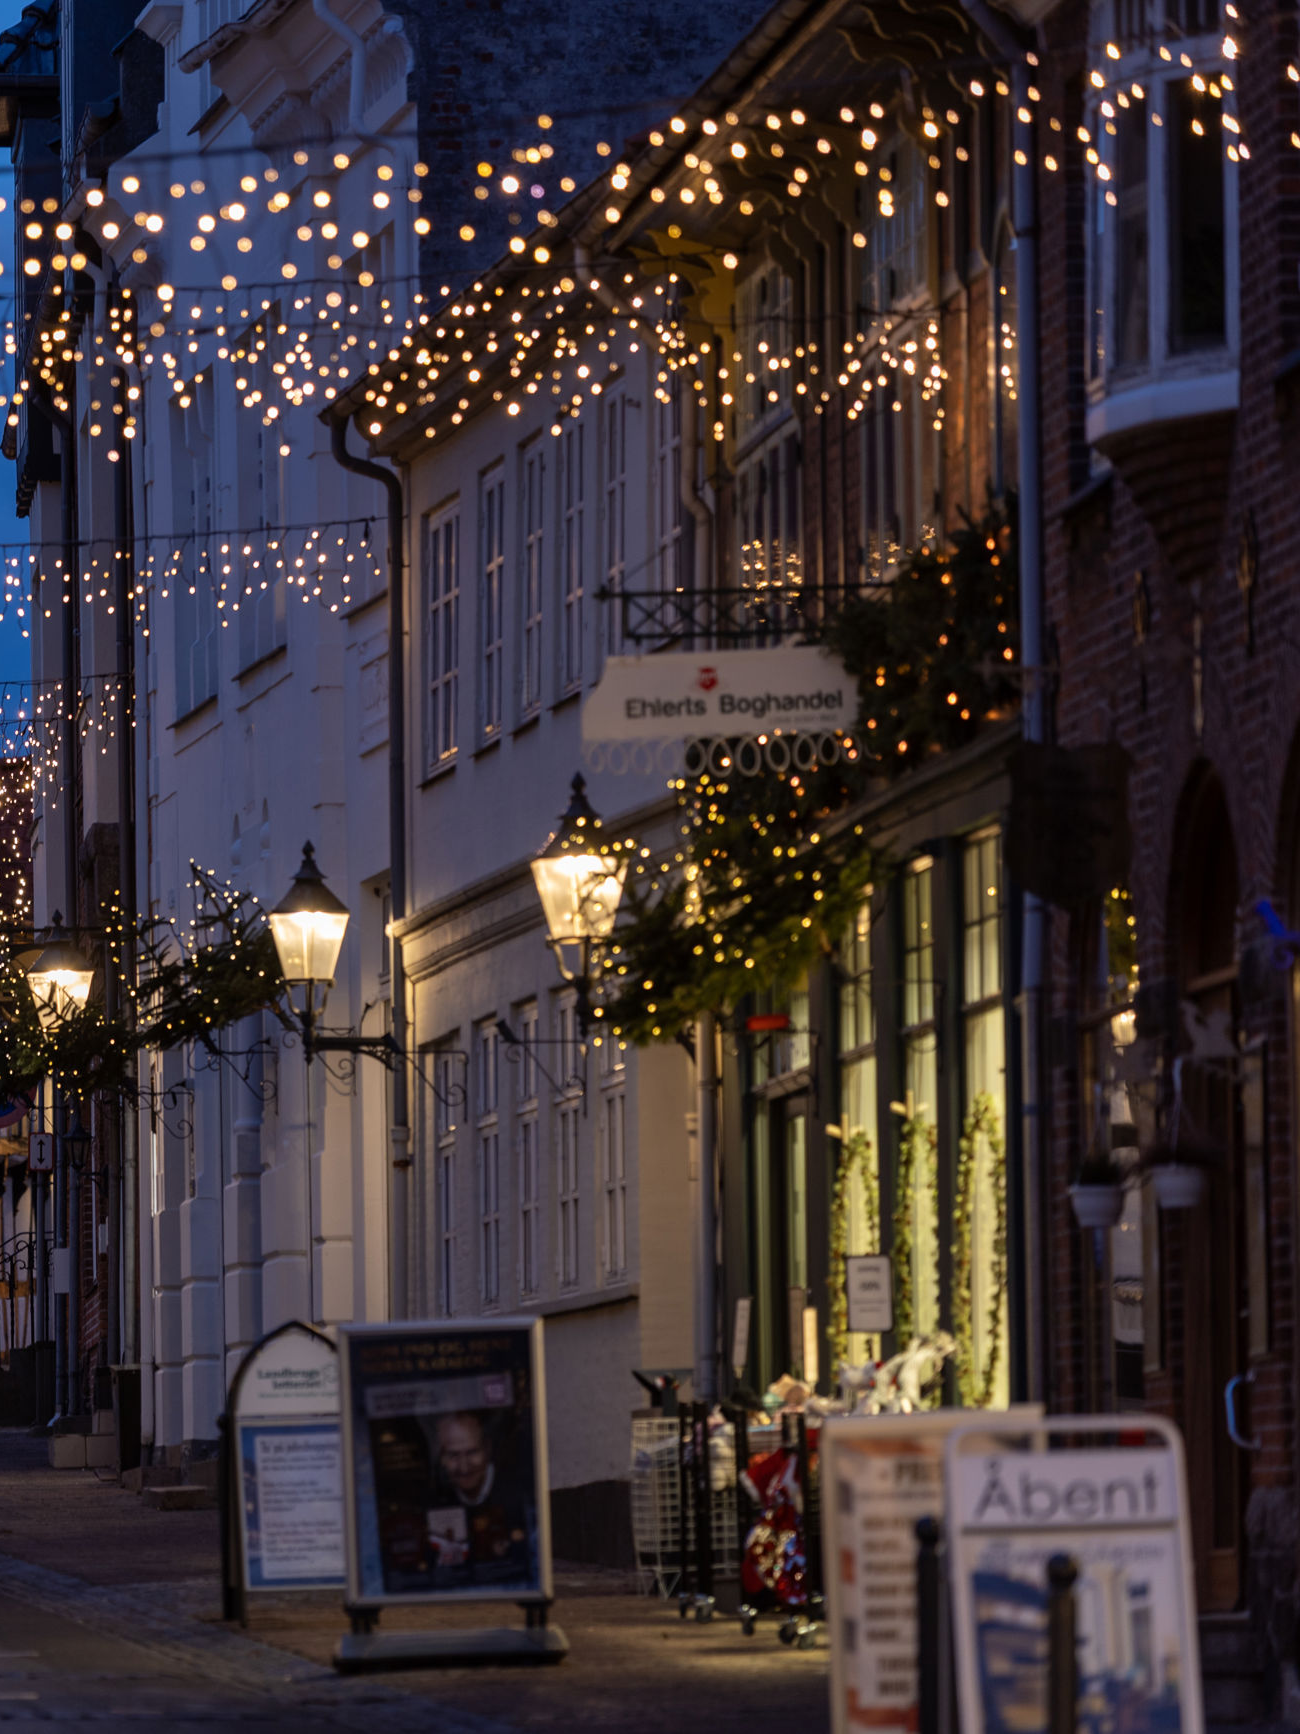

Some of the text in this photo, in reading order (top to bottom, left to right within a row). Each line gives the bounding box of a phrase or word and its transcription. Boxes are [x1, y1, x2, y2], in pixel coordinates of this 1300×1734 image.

[624, 690, 844, 719] Ehlerts Boghandel
[972, 1456, 1160, 1523] Åbent
